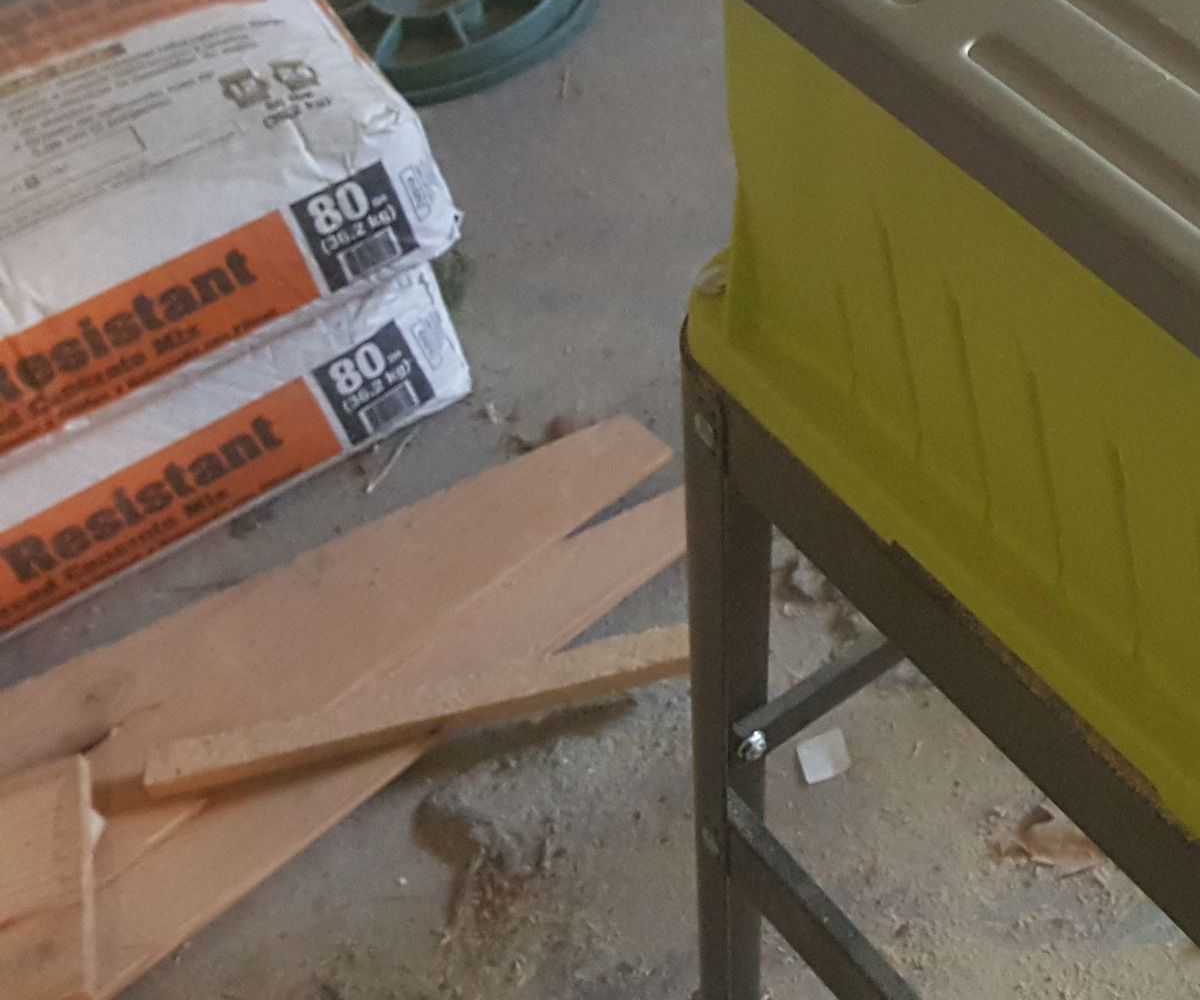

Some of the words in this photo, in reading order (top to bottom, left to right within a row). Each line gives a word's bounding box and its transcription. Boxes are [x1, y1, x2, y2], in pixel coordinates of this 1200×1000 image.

[307, 181, 370, 236] 80
[328, 342, 387, 396] 80
[2, 415, 284, 585] Resistant
